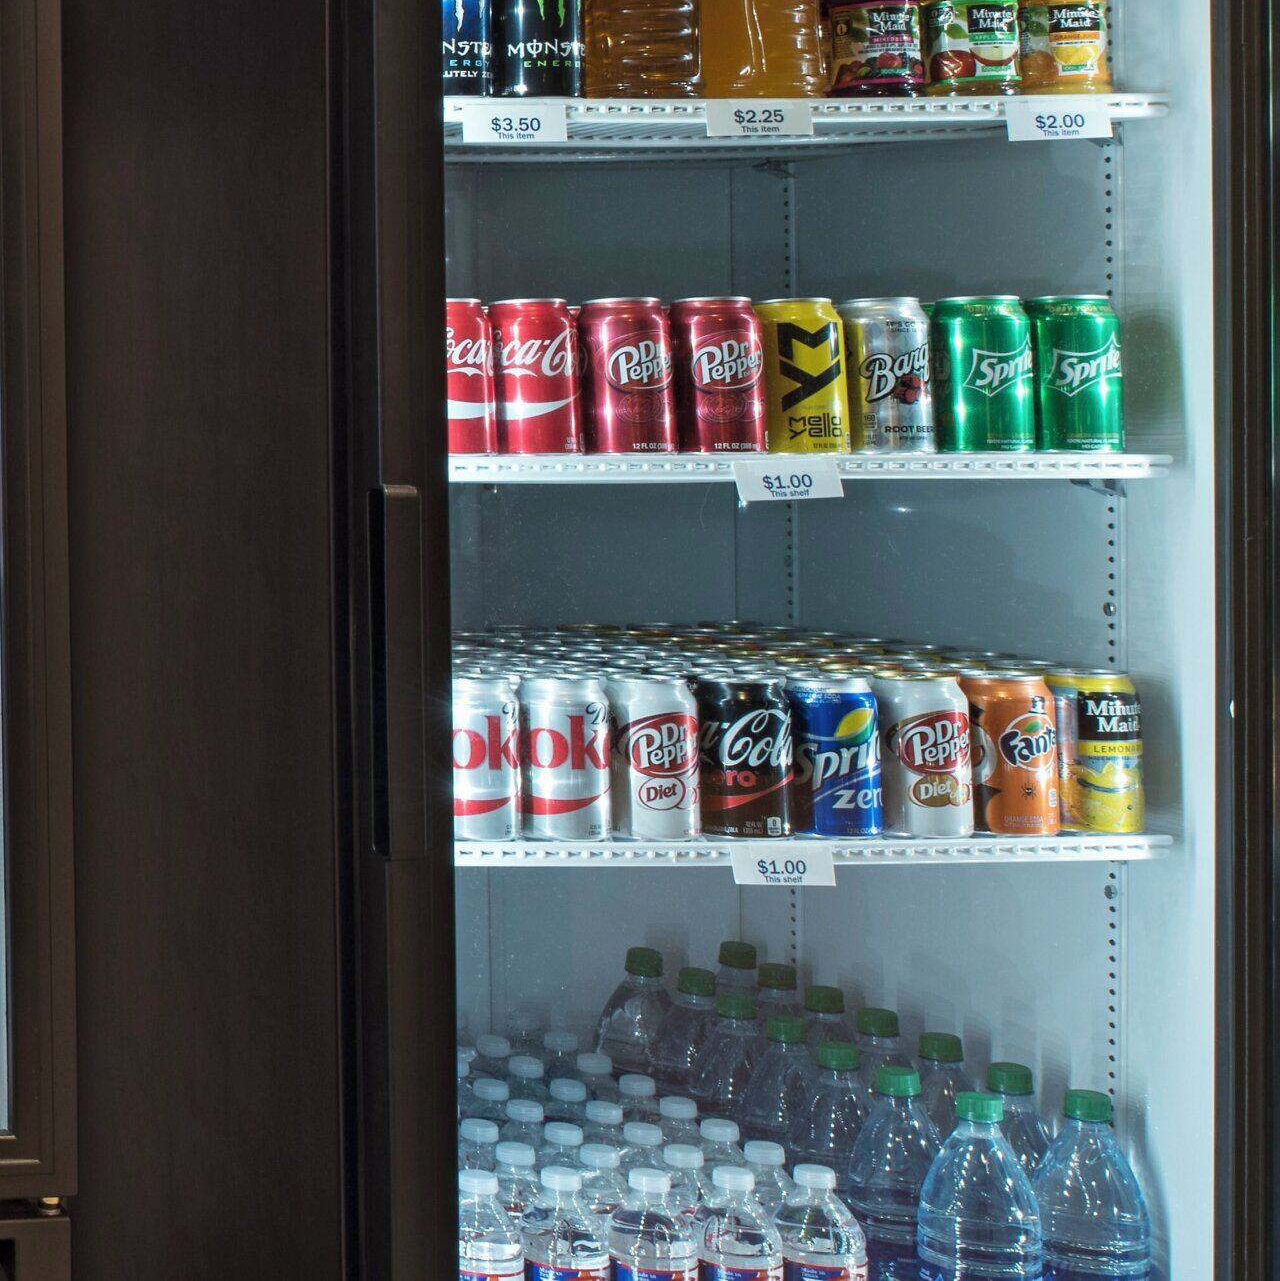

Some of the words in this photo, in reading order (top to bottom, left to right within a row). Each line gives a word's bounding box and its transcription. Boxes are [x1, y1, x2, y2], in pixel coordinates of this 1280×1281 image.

[491, 117, 541, 133] $3.50
[734, 109, 784, 125] $2.25
[1035, 115, 1085, 130] $2.00
[741, 125, 757, 133] This
[760, 125, 780, 133] item
[722, 340, 750, 361] Dr
[700, 347, 762, 385] Pepper
[762, 474, 813, 490] $1.00
[935, 719, 962, 745] Dr
[913, 726, 969, 766] Pepper
[646, 783, 678, 801] Diet
[919, 780, 952, 800] Diet
[758, 860, 806, 875] $1.00
[765, 875, 780, 883] This
